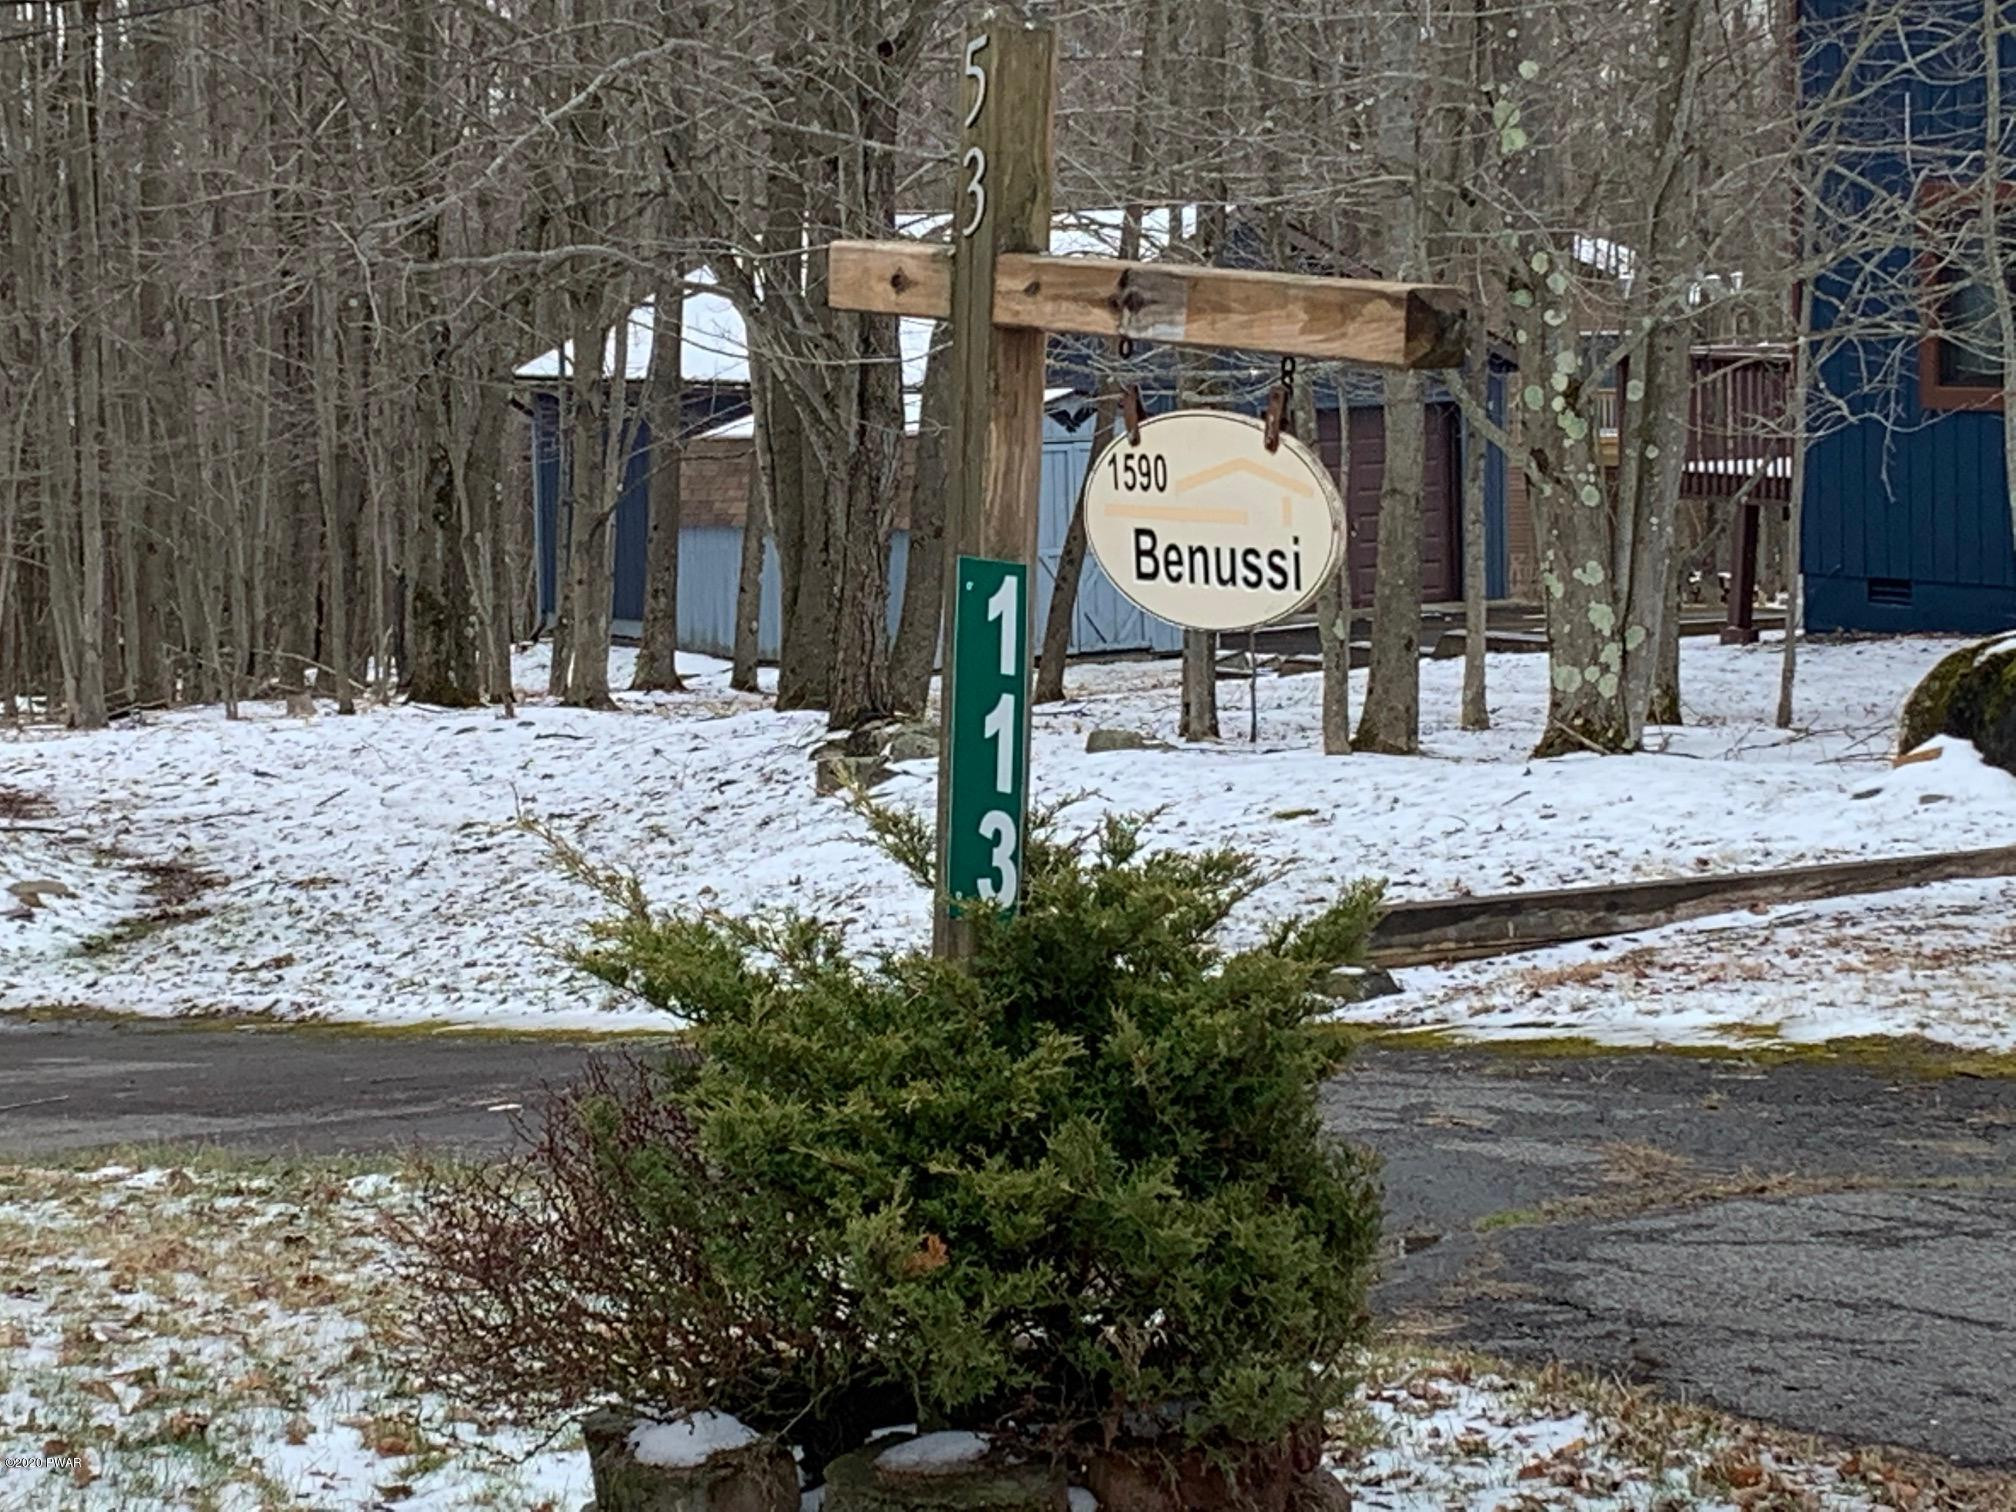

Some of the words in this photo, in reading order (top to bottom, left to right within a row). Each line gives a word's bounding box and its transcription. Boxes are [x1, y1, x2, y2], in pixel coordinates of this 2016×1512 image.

[1108, 453, 1168, 492] 1590
[1133, 528, 1302, 591] Benussi
[977, 575, 1018, 909] 113
